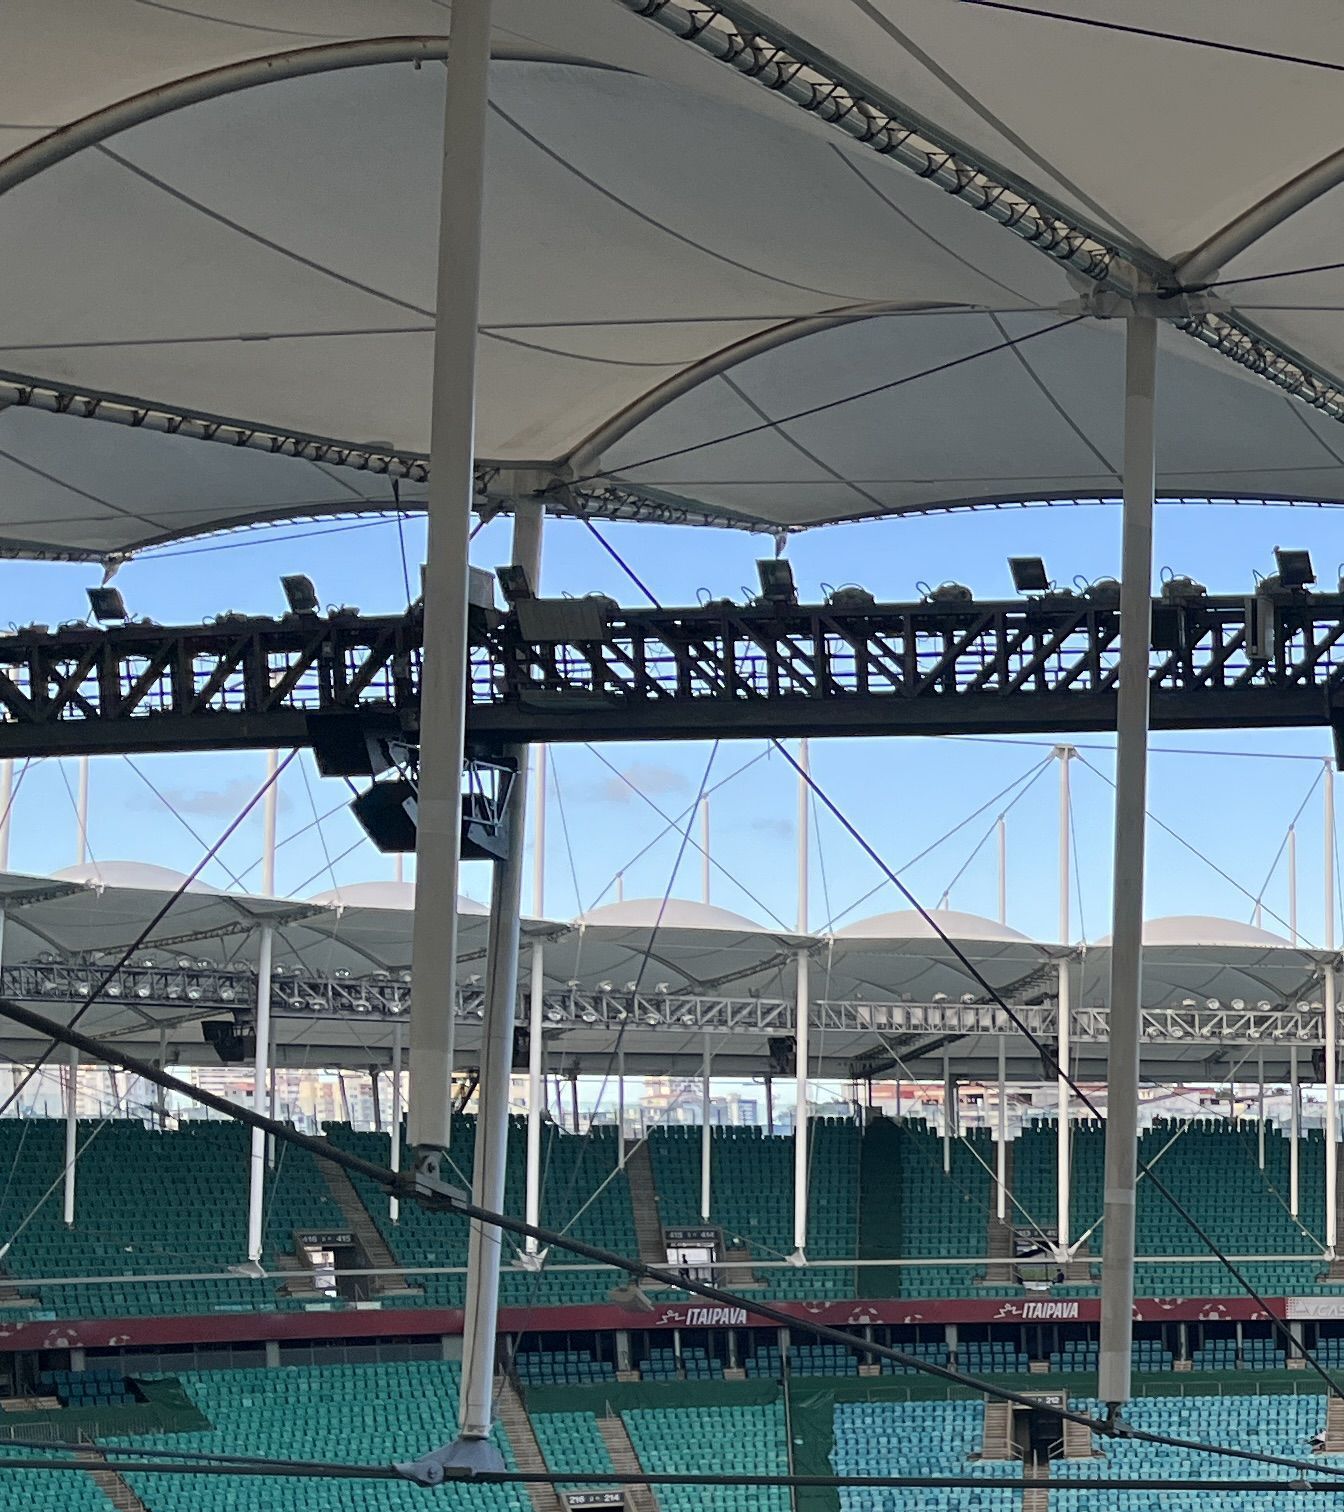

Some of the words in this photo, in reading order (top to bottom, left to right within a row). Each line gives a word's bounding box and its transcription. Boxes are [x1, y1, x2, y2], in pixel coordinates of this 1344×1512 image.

[686, 1307, 748, 1326] ITAIPAVA
[1021, 1301, 1080, 1320] ITAIPAVA
[604, 1494, 621, 1502] 214
